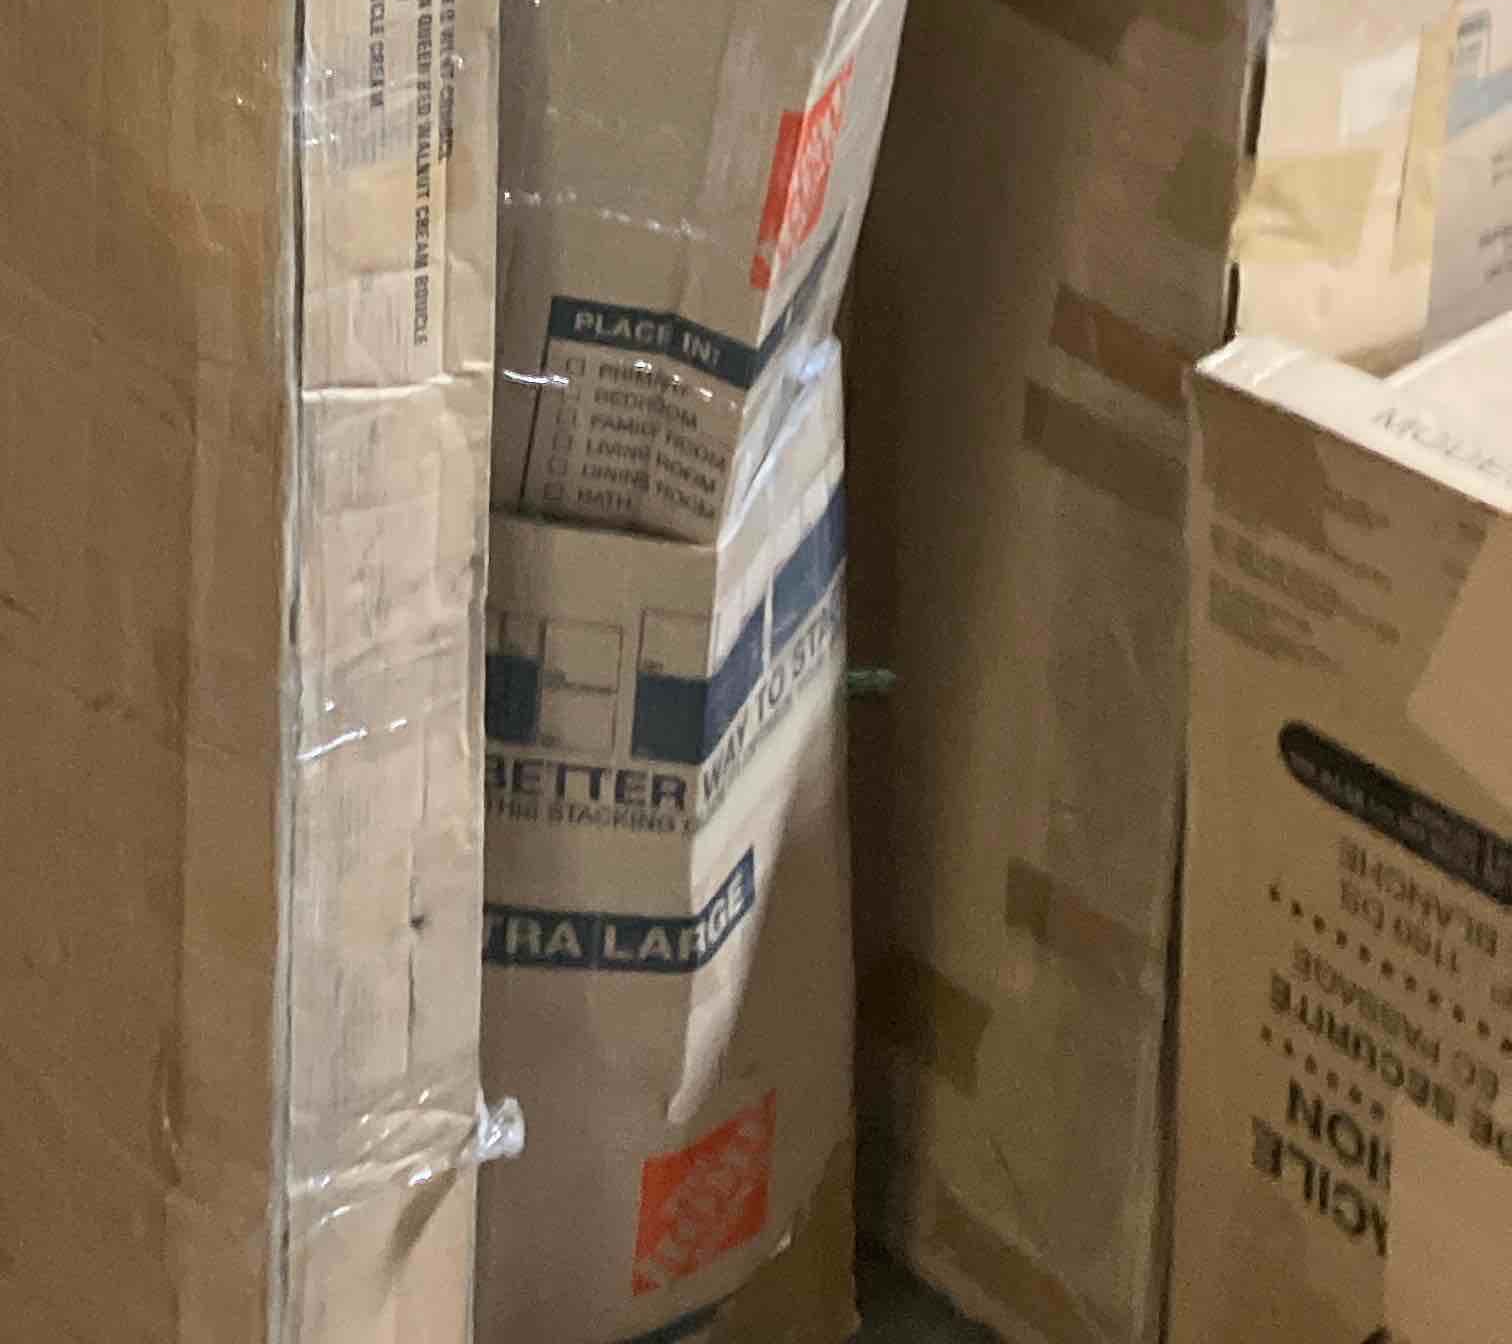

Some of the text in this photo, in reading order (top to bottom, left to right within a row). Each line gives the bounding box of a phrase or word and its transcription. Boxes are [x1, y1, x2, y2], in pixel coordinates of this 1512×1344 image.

[417, 13, 433, 75] QUEEN
[415, 120, 433, 202] WALNUT
[414, 204, 431, 270] CREAM
[412, 275, 430, 347] BOUCLE
[573, 310, 673, 345] PLACE
[603, 872, 745, 961] LARGE
